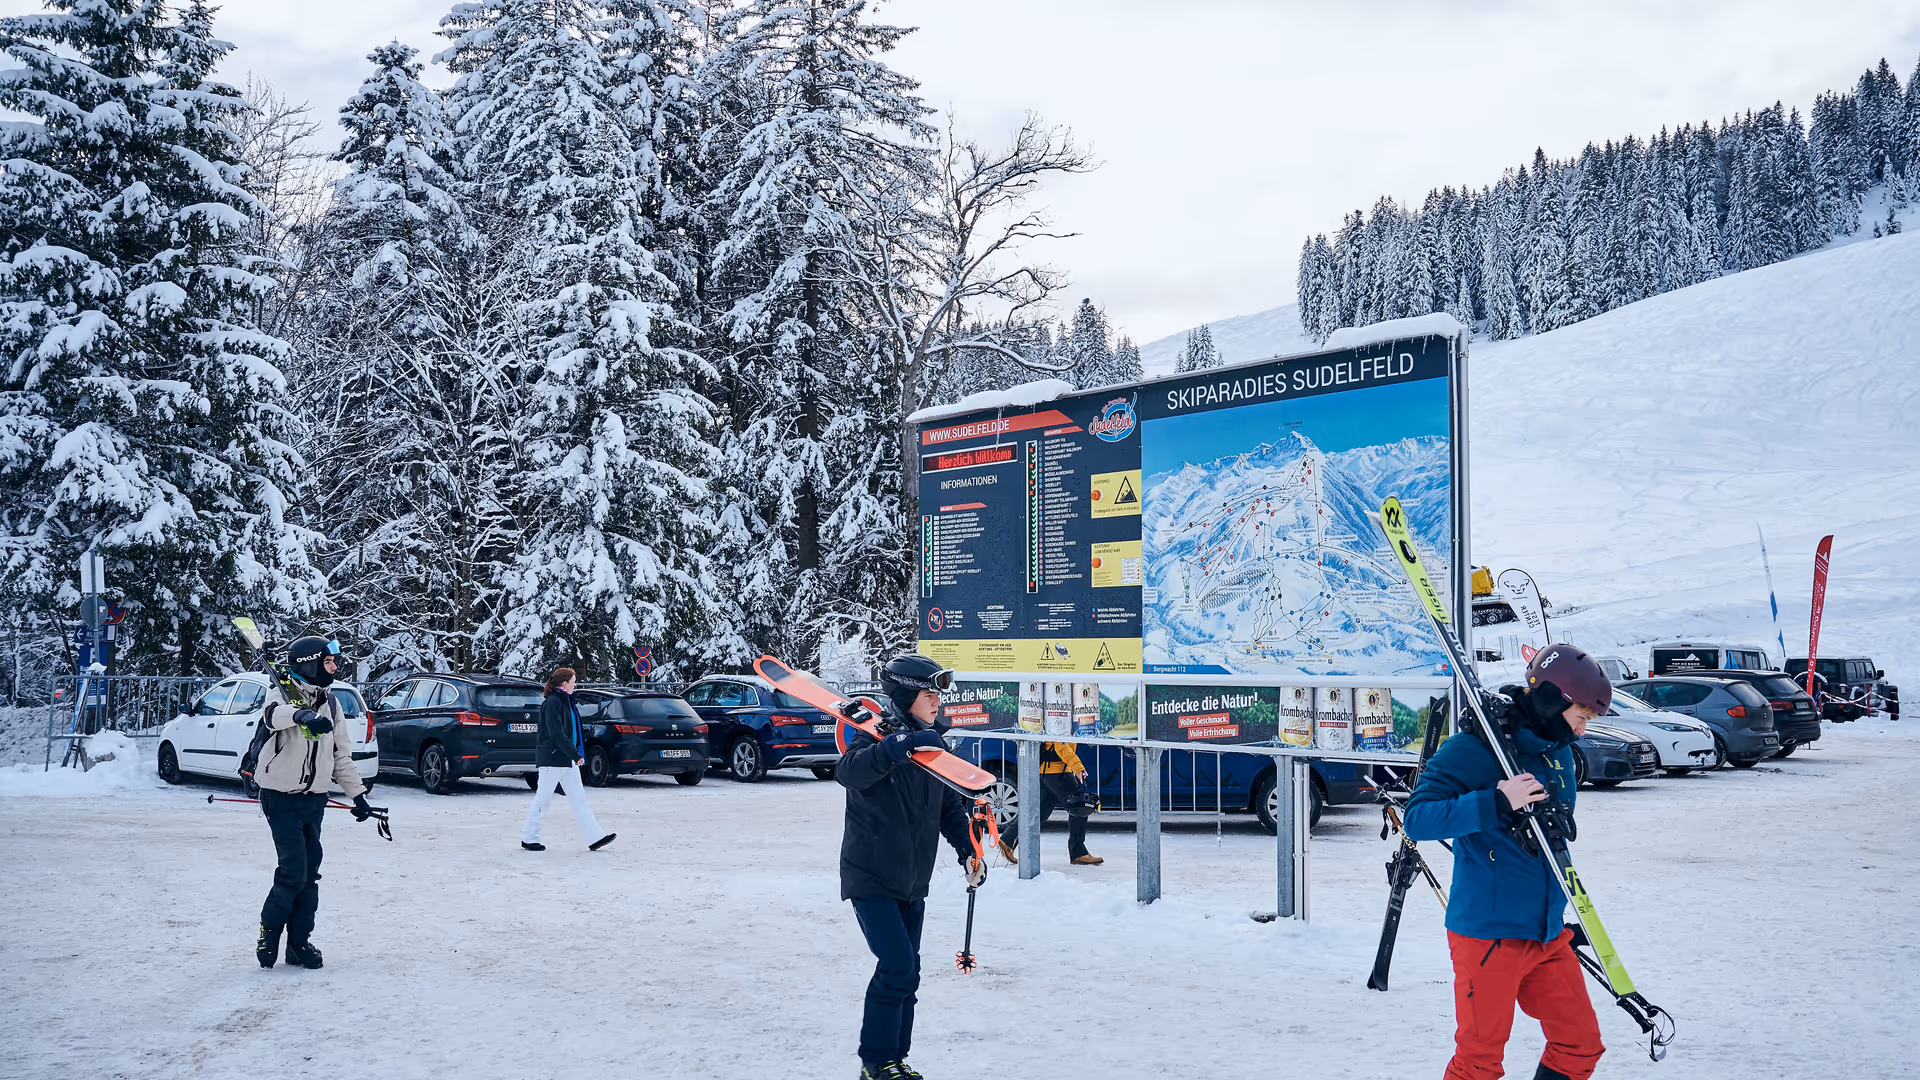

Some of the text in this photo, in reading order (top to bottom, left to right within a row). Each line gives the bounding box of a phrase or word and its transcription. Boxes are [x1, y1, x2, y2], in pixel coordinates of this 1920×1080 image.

[1166, 352, 1414, 410] SKIPARADIES SUDELFELD
[930, 420, 1010, 442] WWW.SUDELFELD.DE
[1088, 413, 1134, 438] Sudelfeld
[938, 452, 972, 468] Herzlich
[941, 475, 997, 490] INFORMATIONEN
[962, 689, 974, 702] die
[976, 686, 1003, 700] Natur!
[1152, 692, 1258, 715] Entdecke die Natur!
[1196, 715, 1228, 724] Geschmack.
[1354, 712, 1392, 726] Krombacher
[1204, 728, 1237, 737] Erfrischung.
